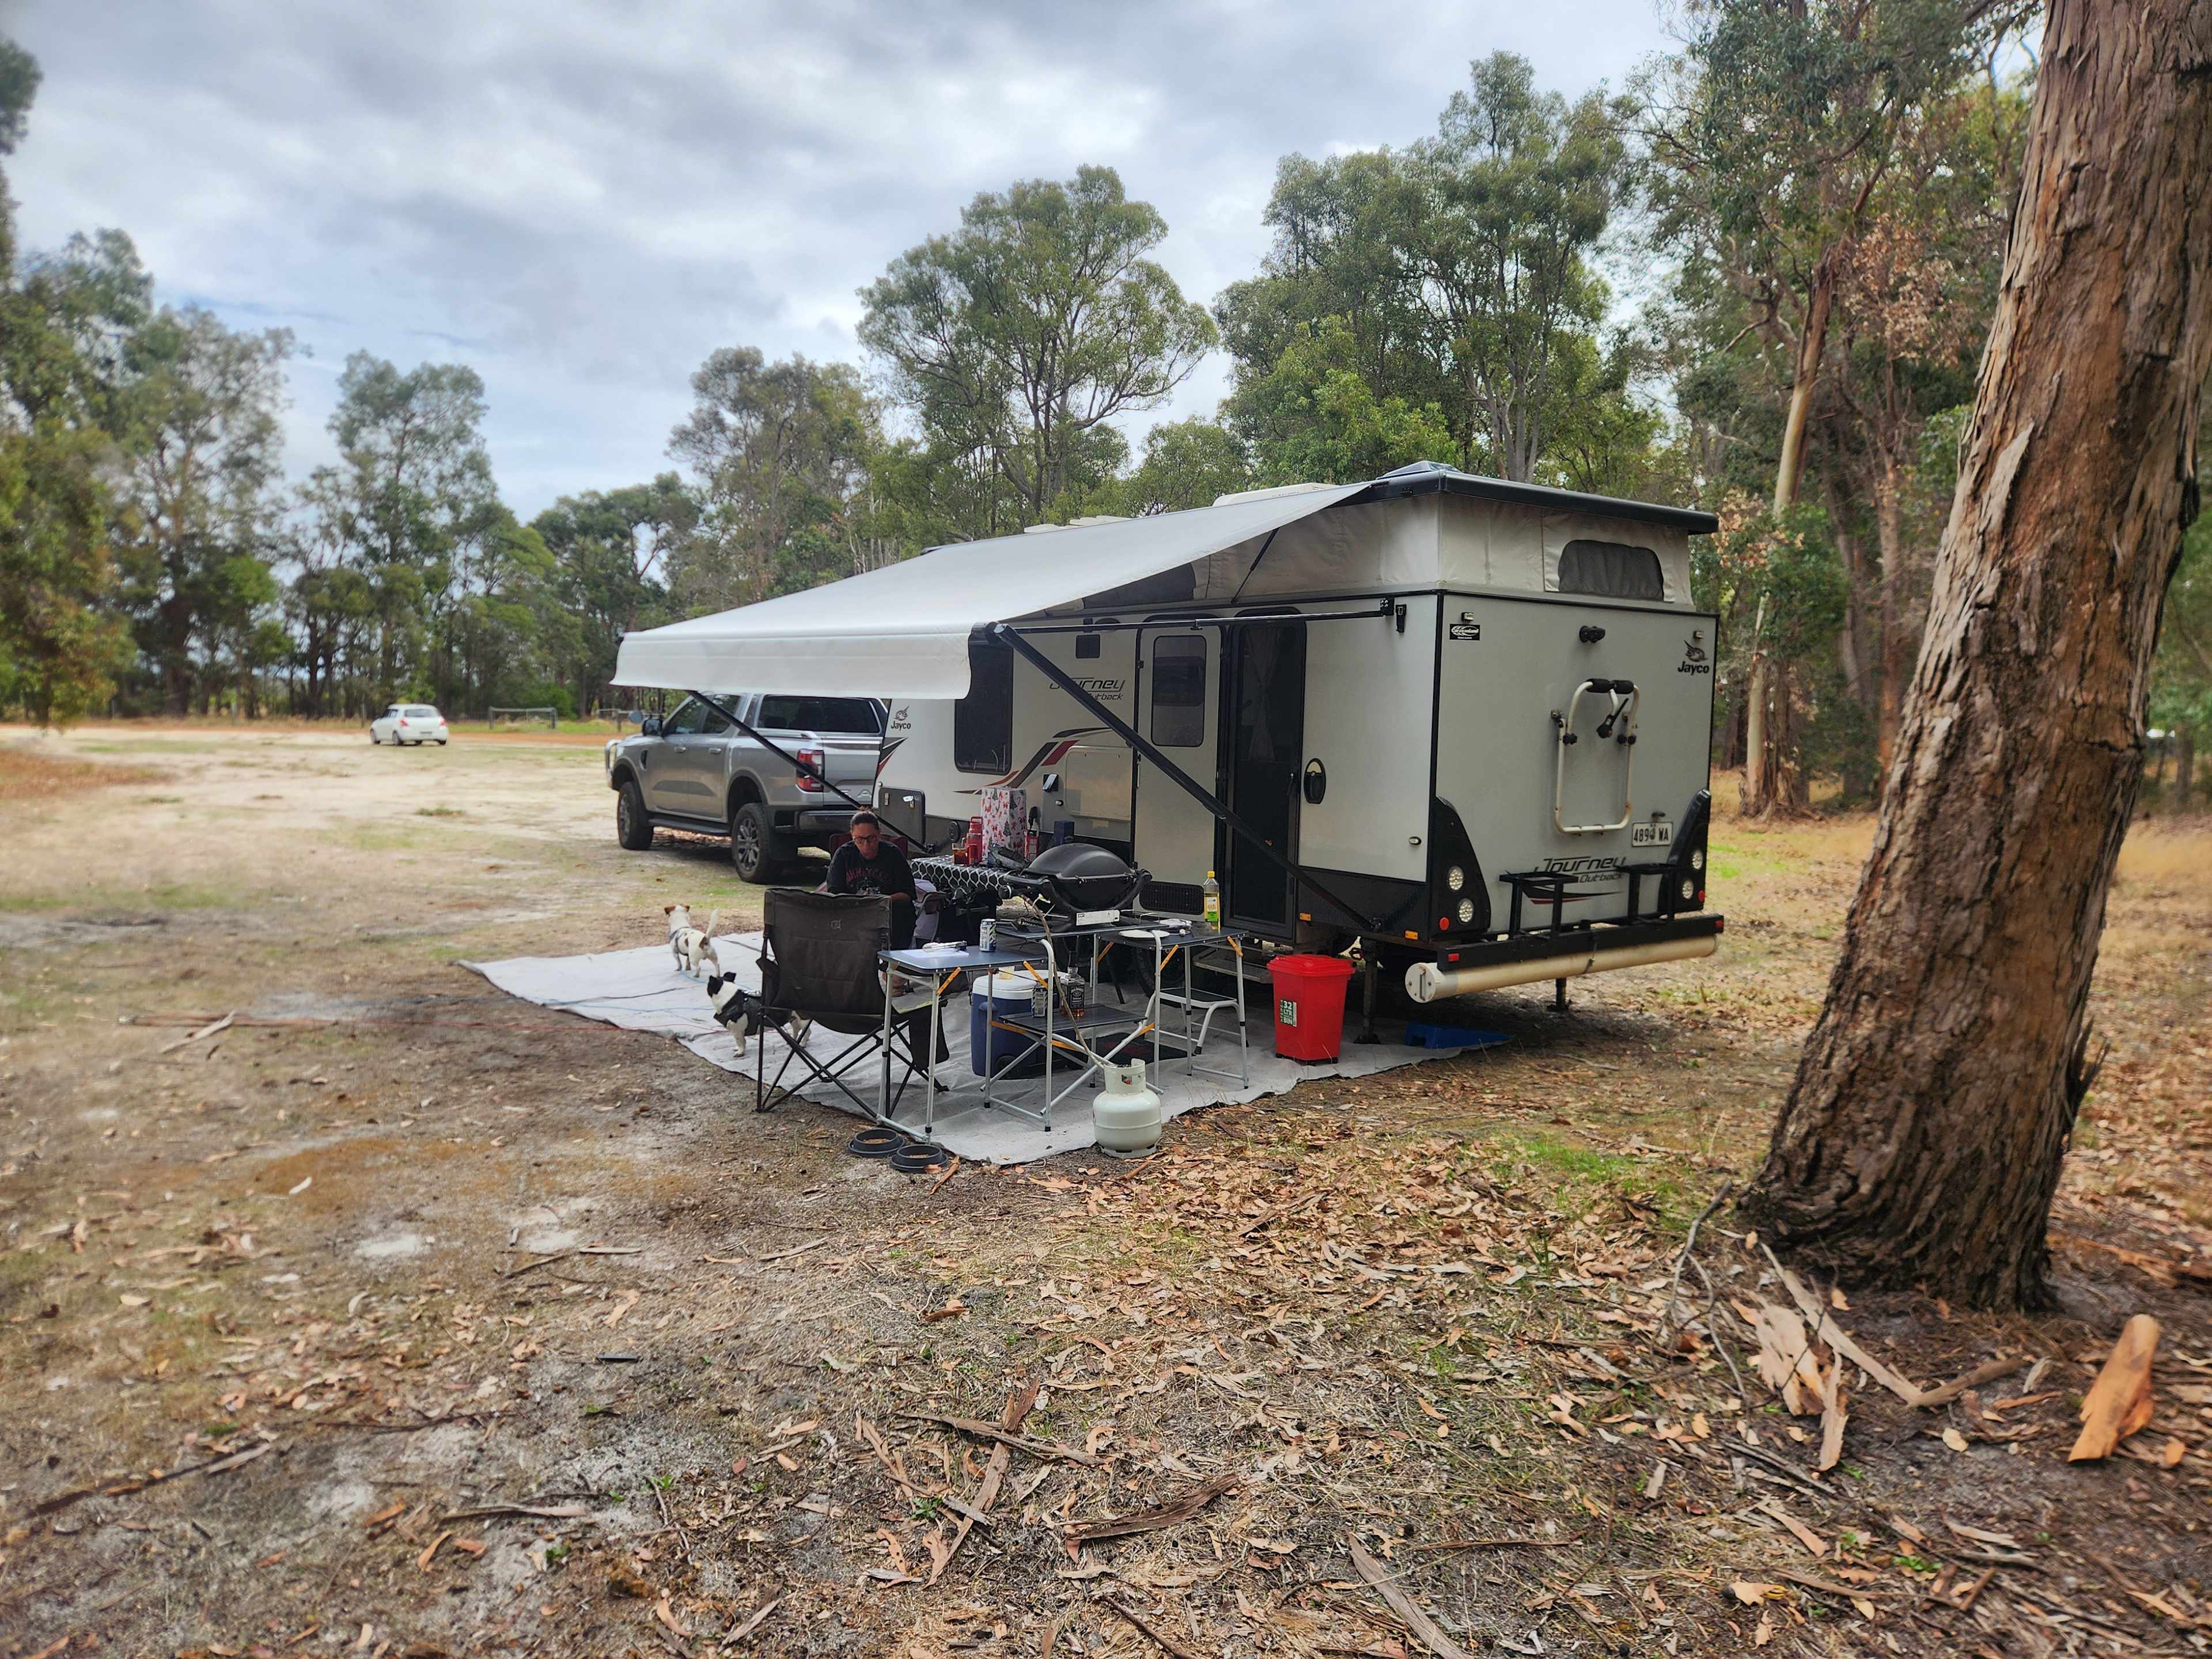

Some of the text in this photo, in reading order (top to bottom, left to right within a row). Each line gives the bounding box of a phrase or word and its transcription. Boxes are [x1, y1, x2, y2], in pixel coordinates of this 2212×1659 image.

[1677, 661, 1710, 676] Jayco
[891, 721, 911, 731] Jayco
[1659, 828, 1669, 842] WA
[1579, 873, 1623, 883] Outback
[1283, 1000, 1292, 1010] 32
[1283, 1017, 1292, 1025] BIN
